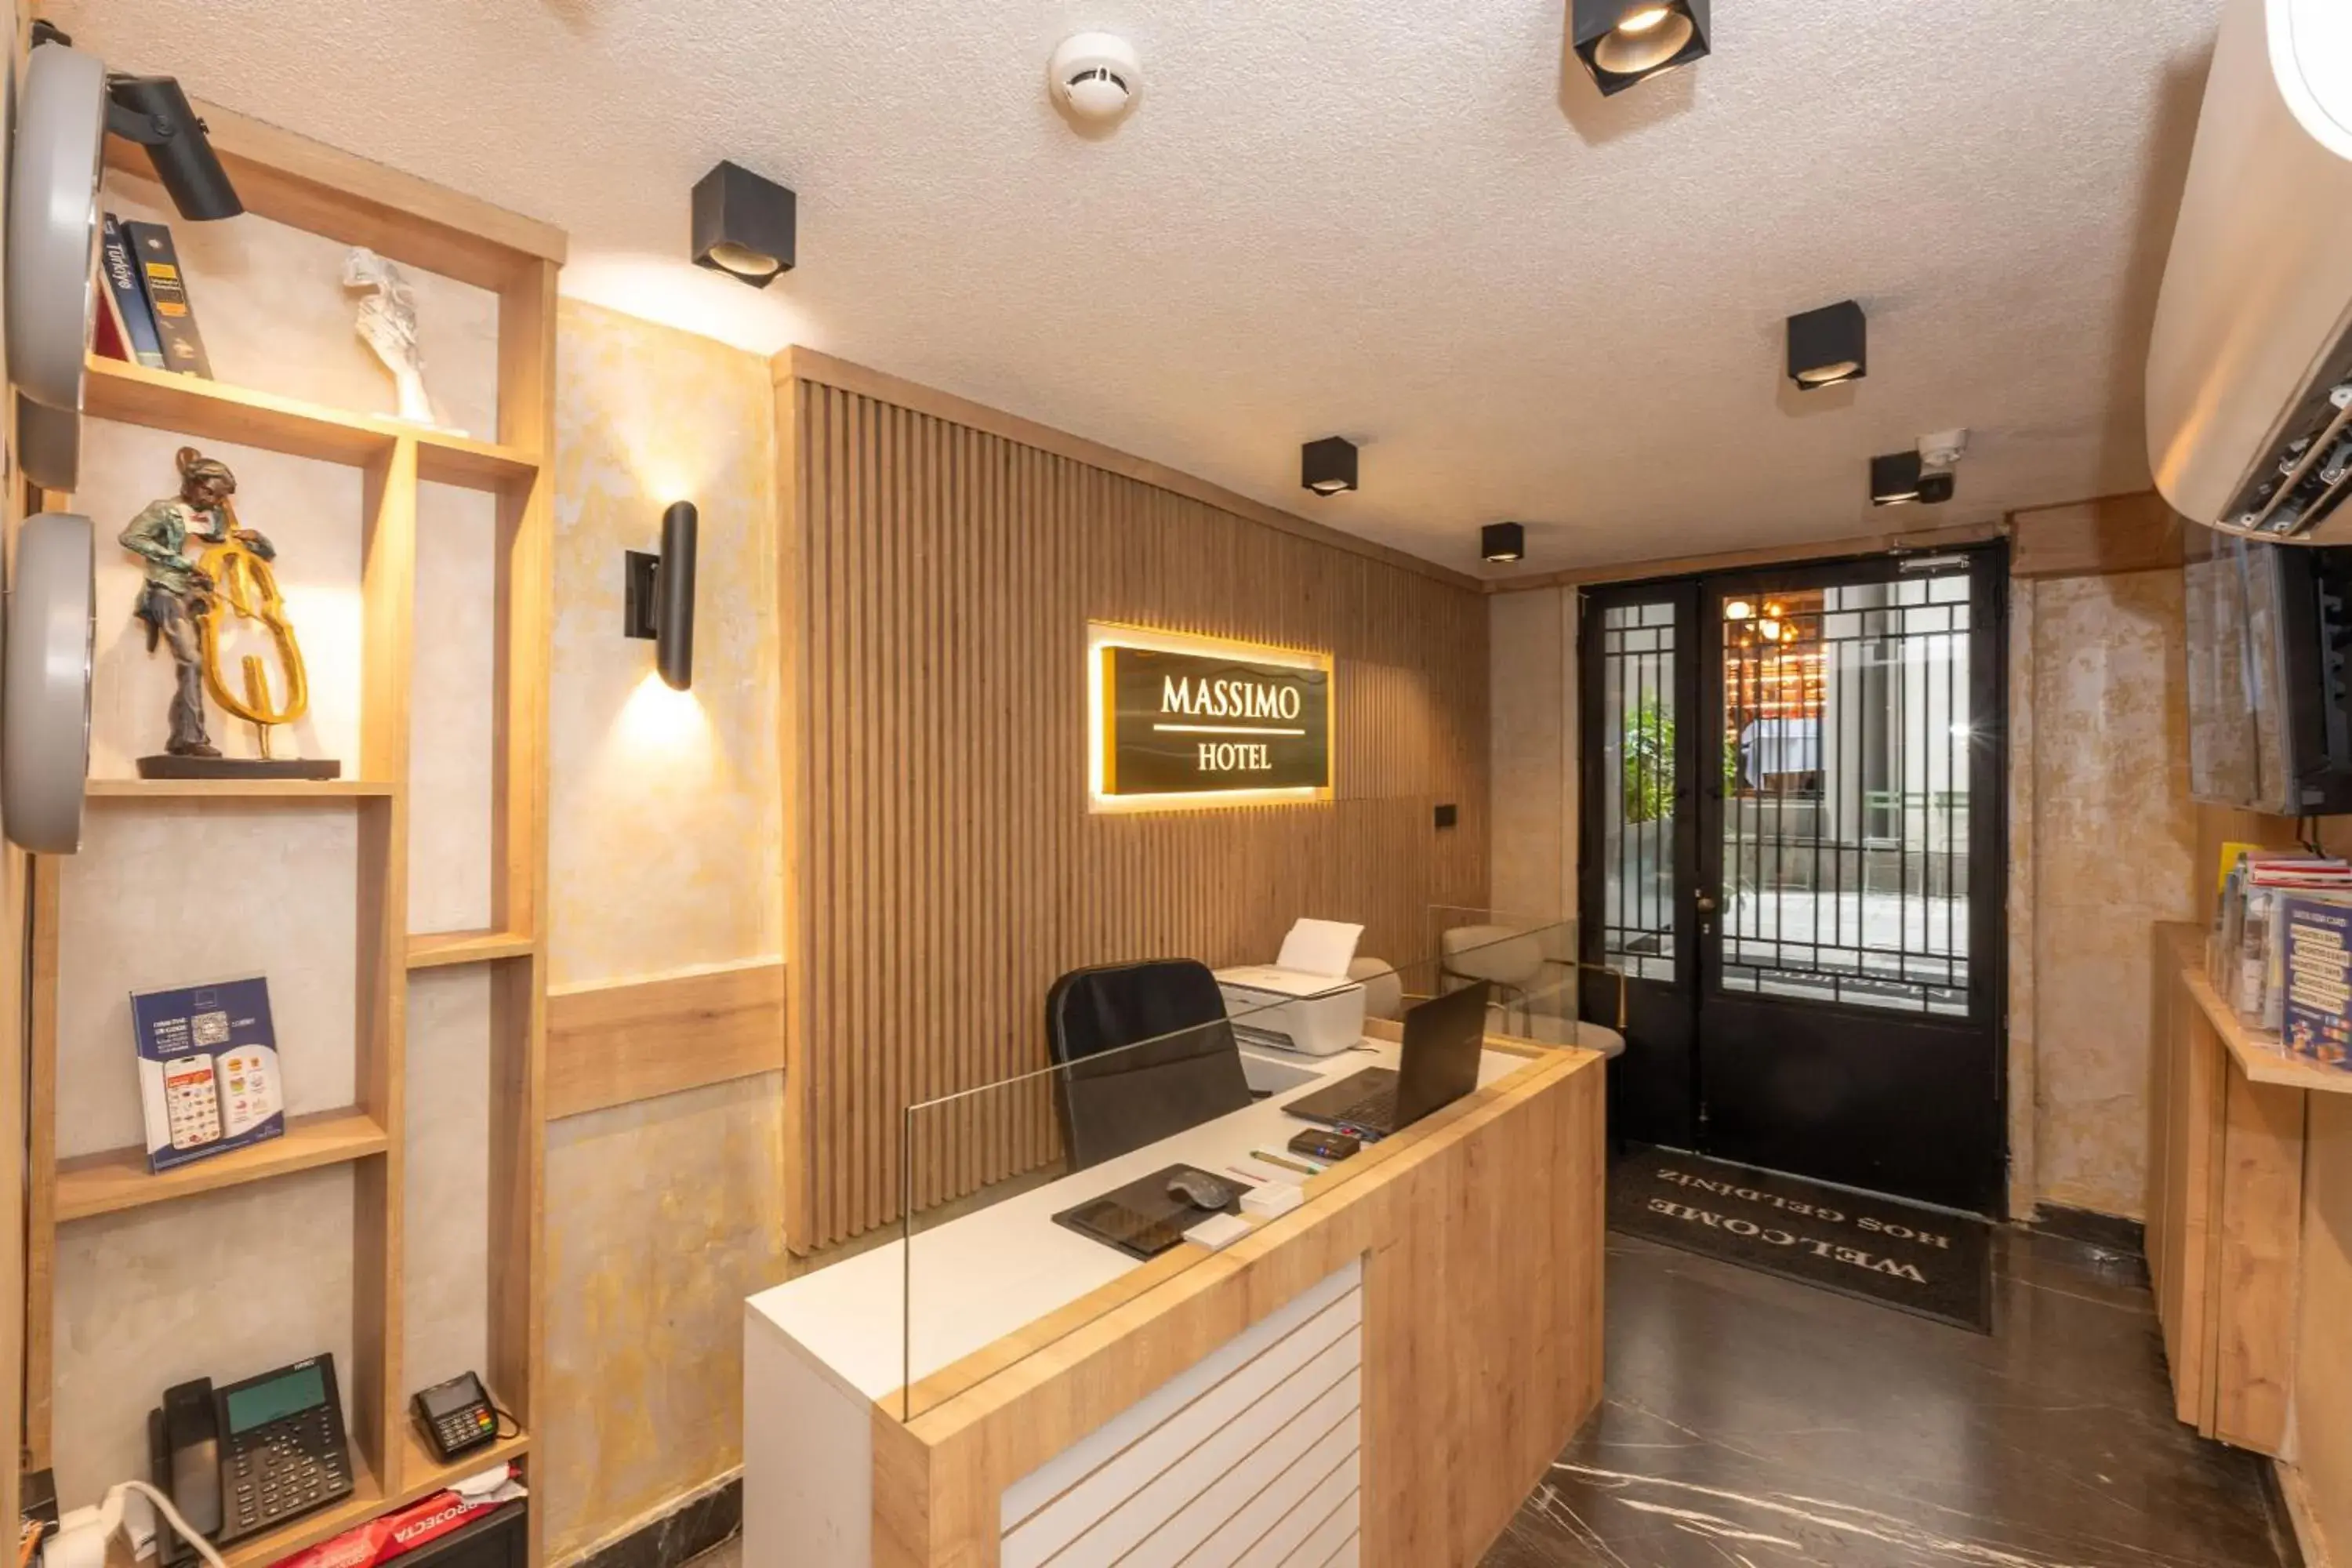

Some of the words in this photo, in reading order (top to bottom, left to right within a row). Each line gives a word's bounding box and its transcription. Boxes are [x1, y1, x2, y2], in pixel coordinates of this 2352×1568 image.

[1160, 675, 1300, 719] MASSIMO
[1197, 742, 1272, 771] HOTEL
[1648, 1199, 1927, 1284] WELCOME
